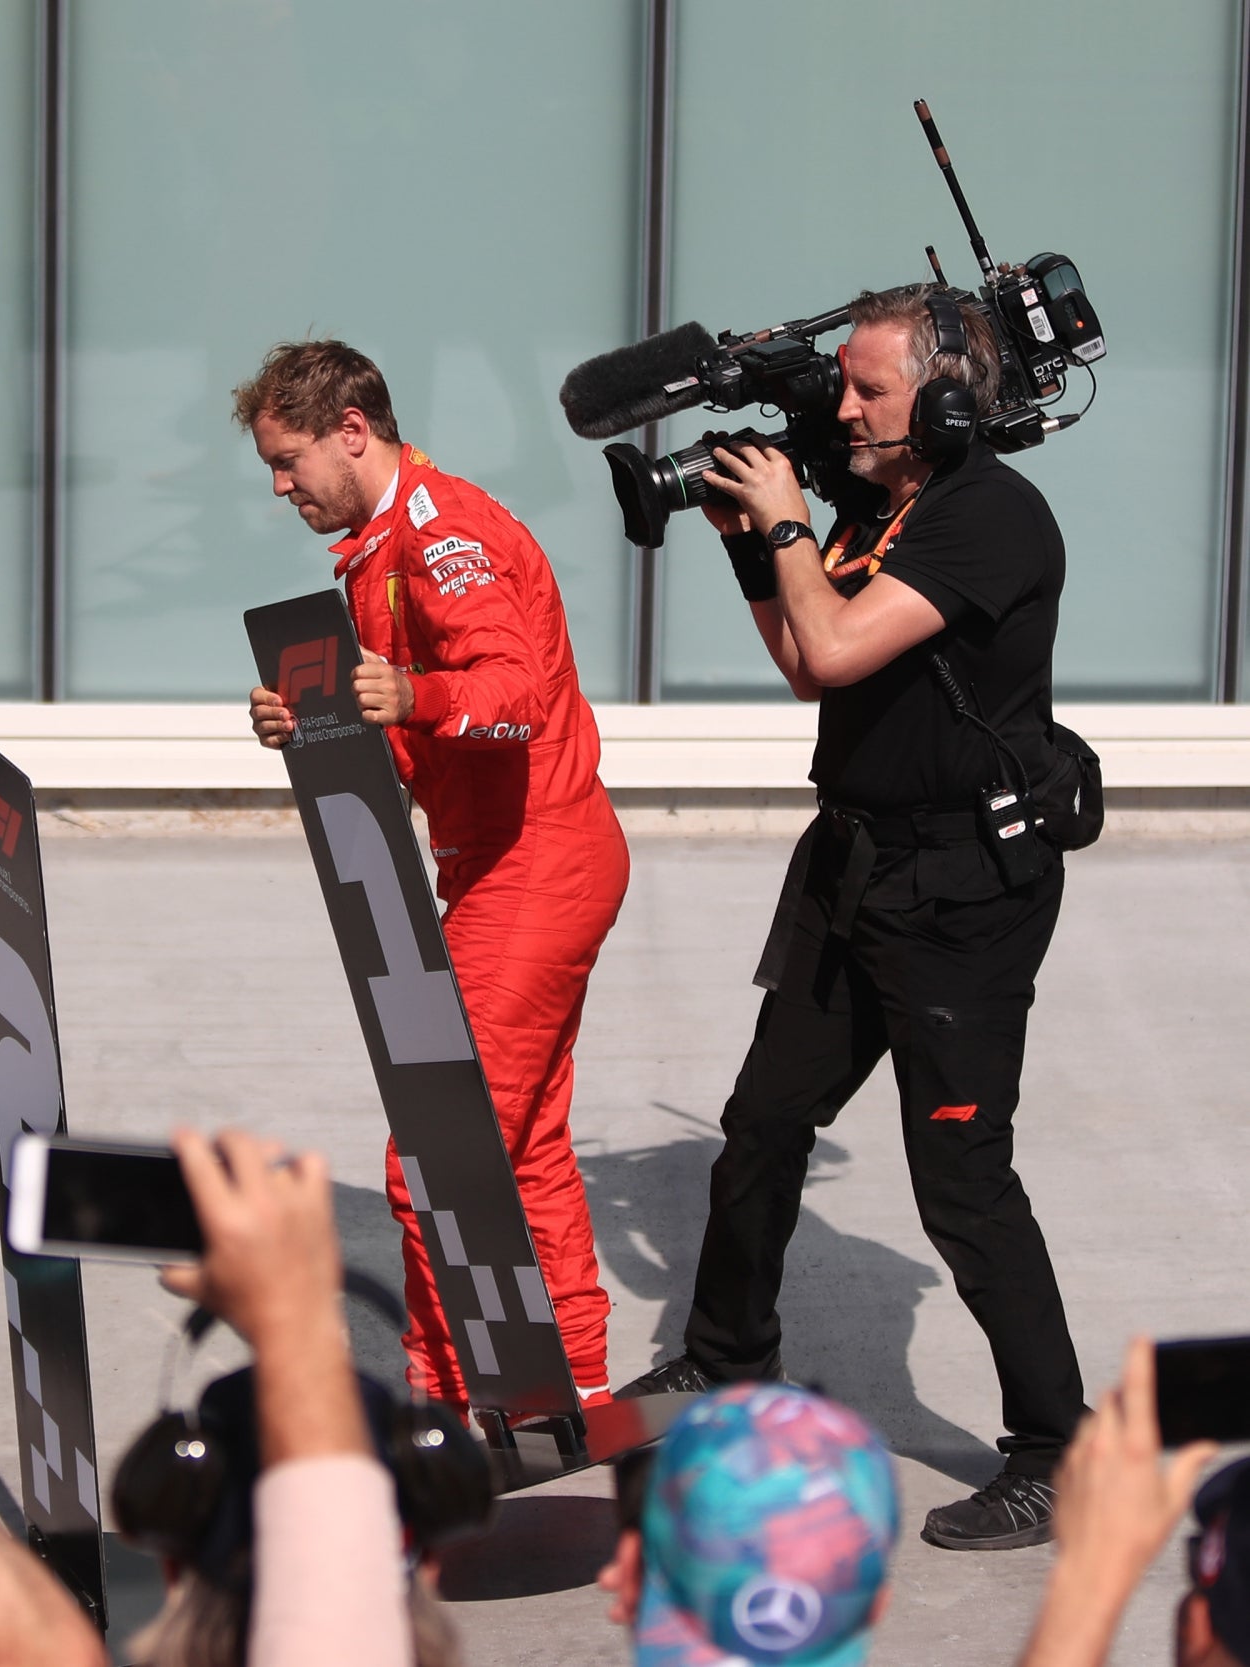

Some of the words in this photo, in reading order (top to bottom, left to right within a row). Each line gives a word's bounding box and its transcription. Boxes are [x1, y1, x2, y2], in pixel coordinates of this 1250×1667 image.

[1033, 356, 1063, 377] DTC
[945, 418, 971, 428] SPEEDY
[425, 539, 481, 562] HUBLT
[431, 554, 490, 583] PIRELLI
[315, 792, 475, 1065] 1
